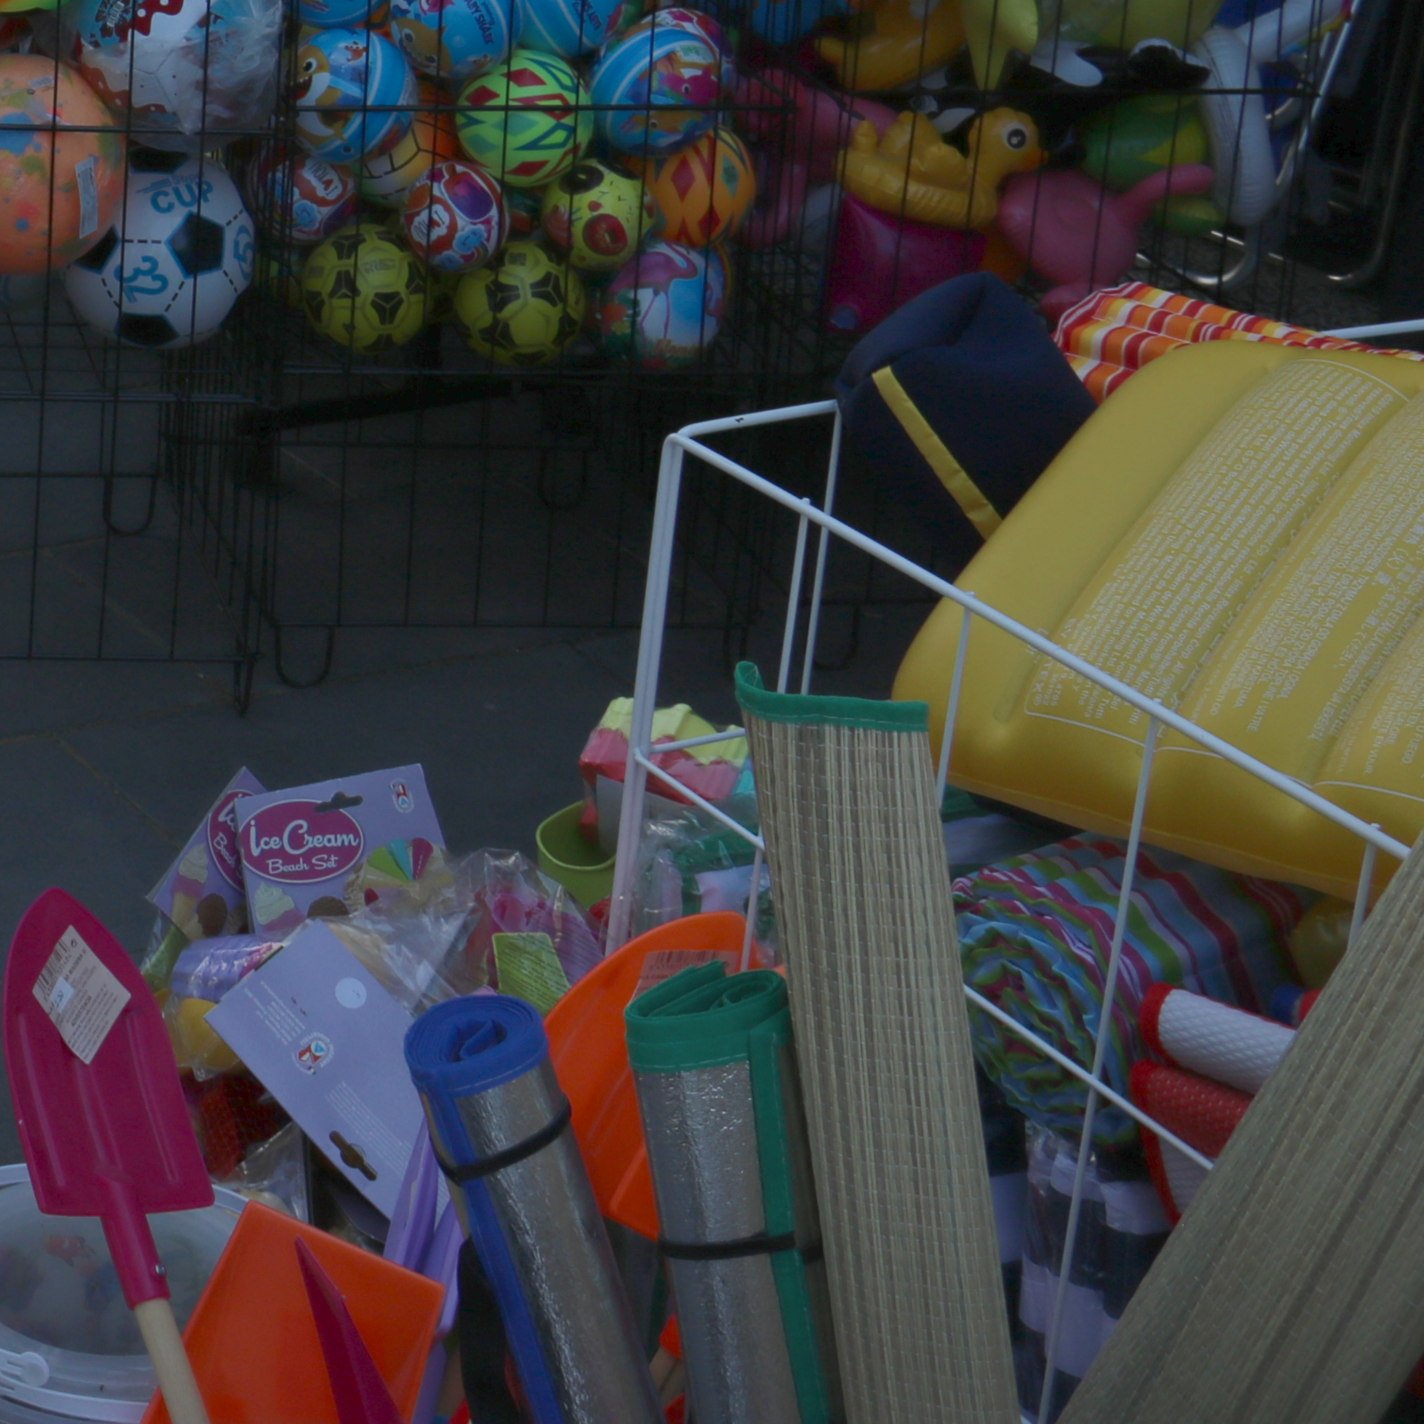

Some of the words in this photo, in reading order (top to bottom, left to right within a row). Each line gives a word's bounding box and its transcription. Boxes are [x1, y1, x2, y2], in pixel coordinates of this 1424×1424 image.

[150, 179, 214, 214] CUP
[248, 819, 282, 857] Ice
[282, 819, 360, 855] Cream
[265, 857, 310, 875] Beach
[311, 853, 339, 871] Set
